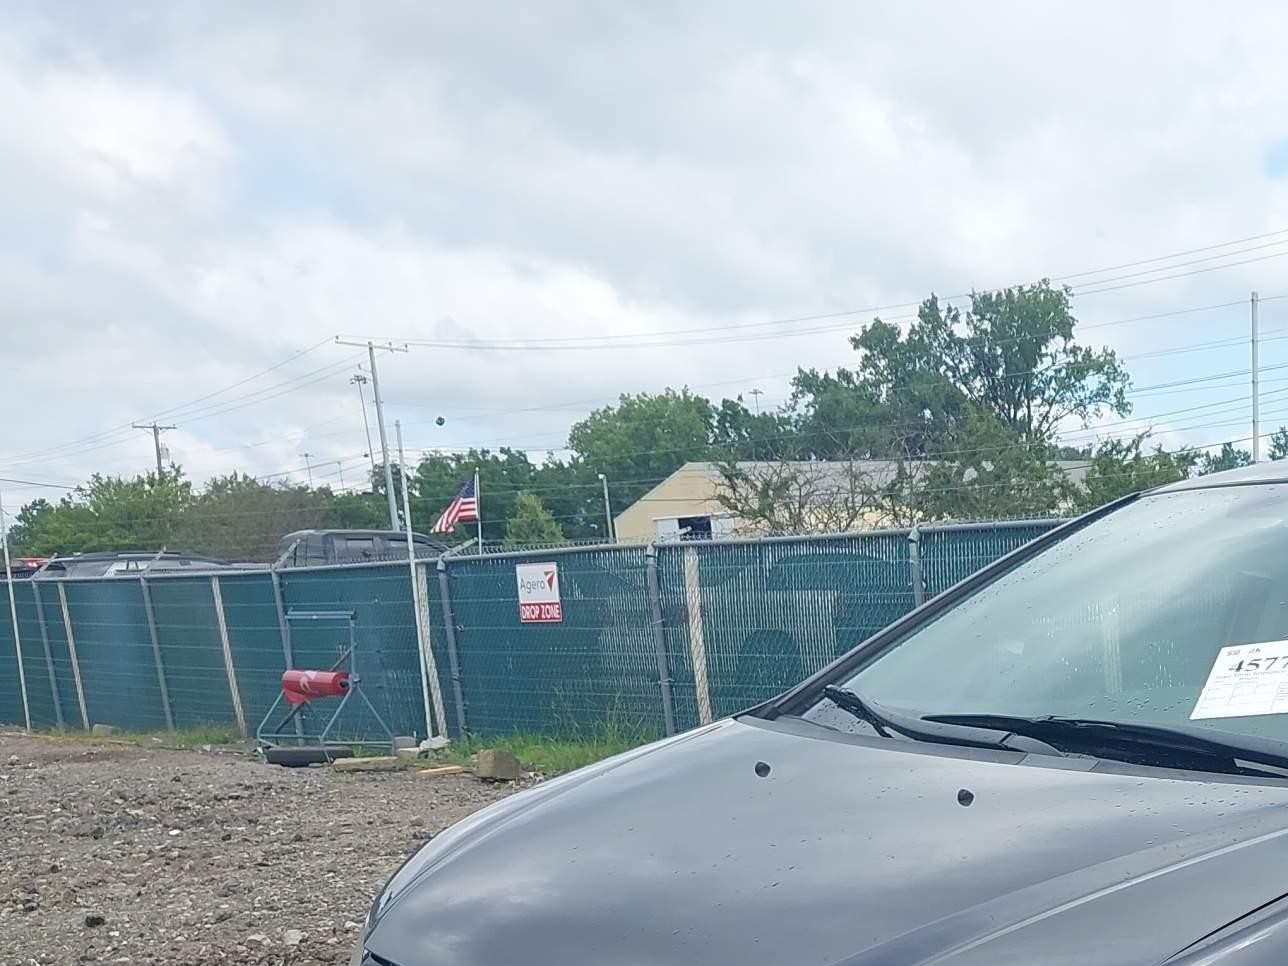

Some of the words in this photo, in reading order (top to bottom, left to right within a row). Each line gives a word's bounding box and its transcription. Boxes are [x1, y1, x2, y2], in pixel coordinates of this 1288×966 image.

[520, 578, 545, 594] Agero
[521, 605, 540, 620] DROP
[540, 604, 560, 619] ZONE
